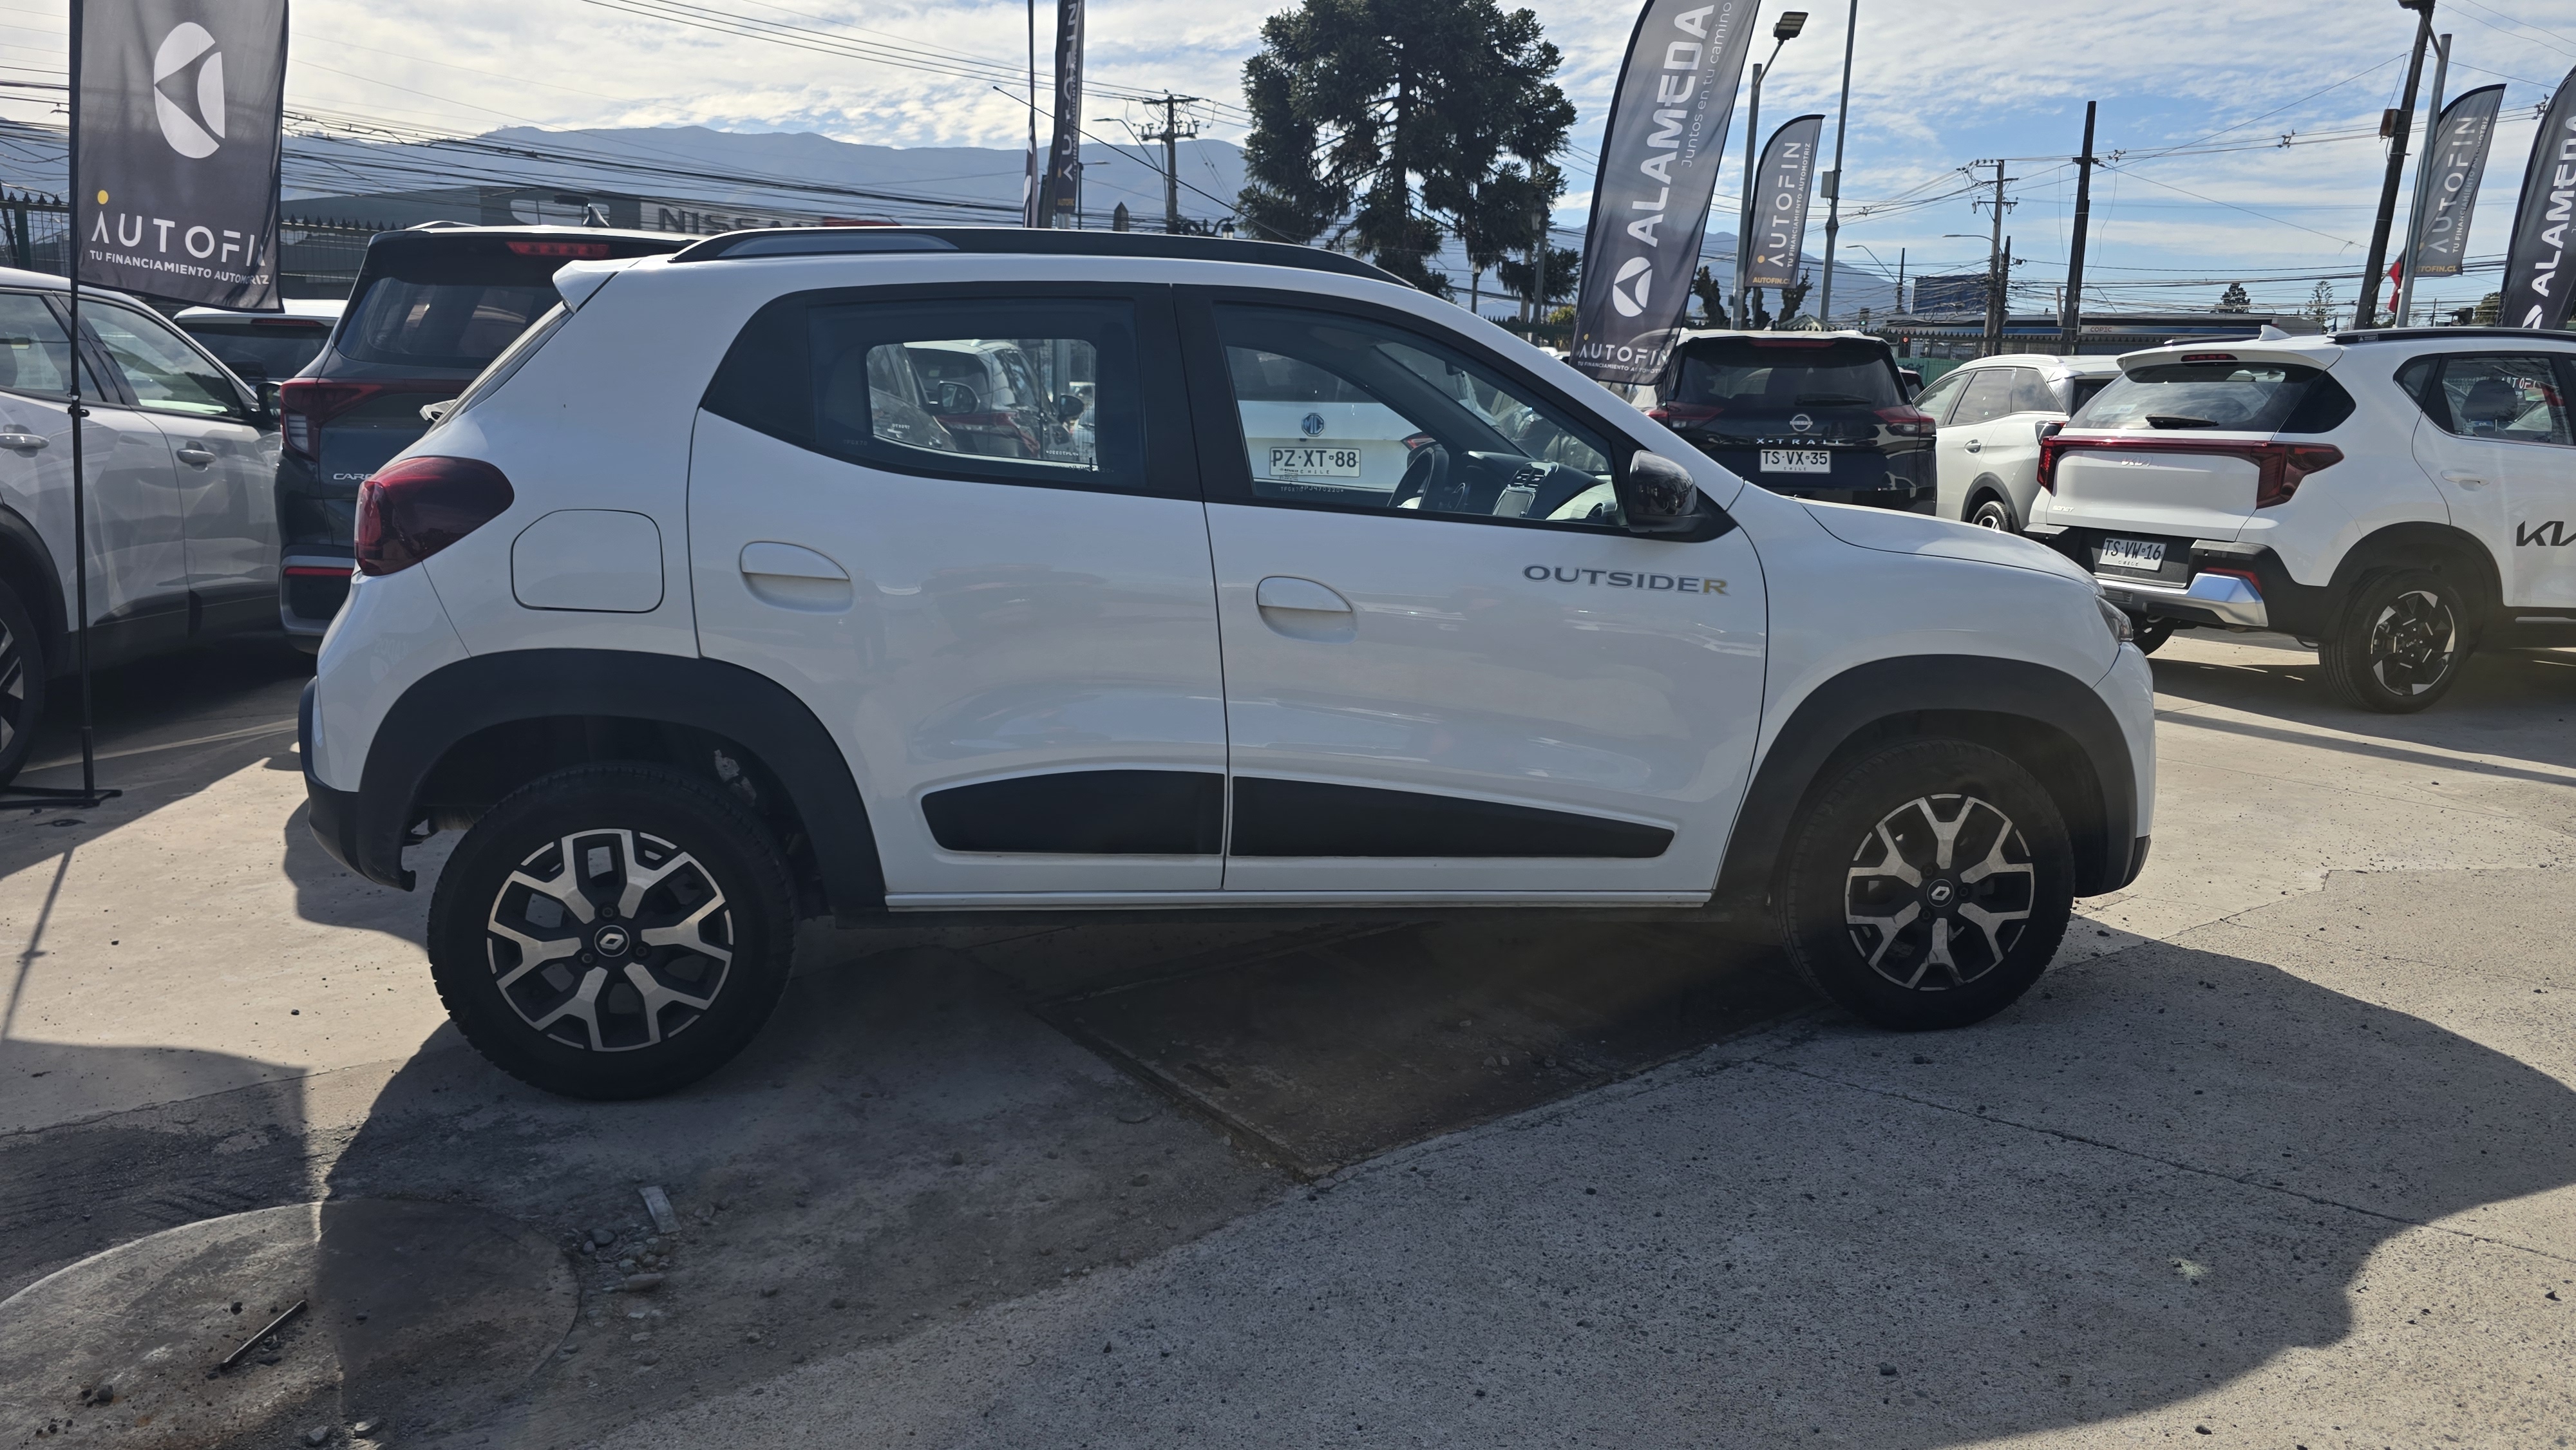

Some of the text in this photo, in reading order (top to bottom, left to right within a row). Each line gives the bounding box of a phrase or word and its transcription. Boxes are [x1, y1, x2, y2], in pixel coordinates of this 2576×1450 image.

[1681, 2, 1732, 167] Juntos en tu camino
[1627, 5, 1715, 247] ALAMEDA
[1767, 142, 1801, 267] AUTOFIN
[1787, 143, 1811, 268] TU FINANCIAMIENTO AUTOMOTRIZ
[2428, 117, 2477, 253] AUTOFIN
[2455, 171, 2475, 241] FINANCIAMIENTO
[90, 250, 102, 261] TU
[106, 252, 212, 278] FINANCIAMIENTO
[91, 211, 266, 267] AUTOFI
[2452, 242, 2459, 254] TU
[1578, 343, 1671, 366] AUTOFIN
[1584, 362, 1629, 372] FINANCIAMIENTO
[1303, 415, 1324, 435] MG
[1522, 565, 1730, 596] OUTSIDER
